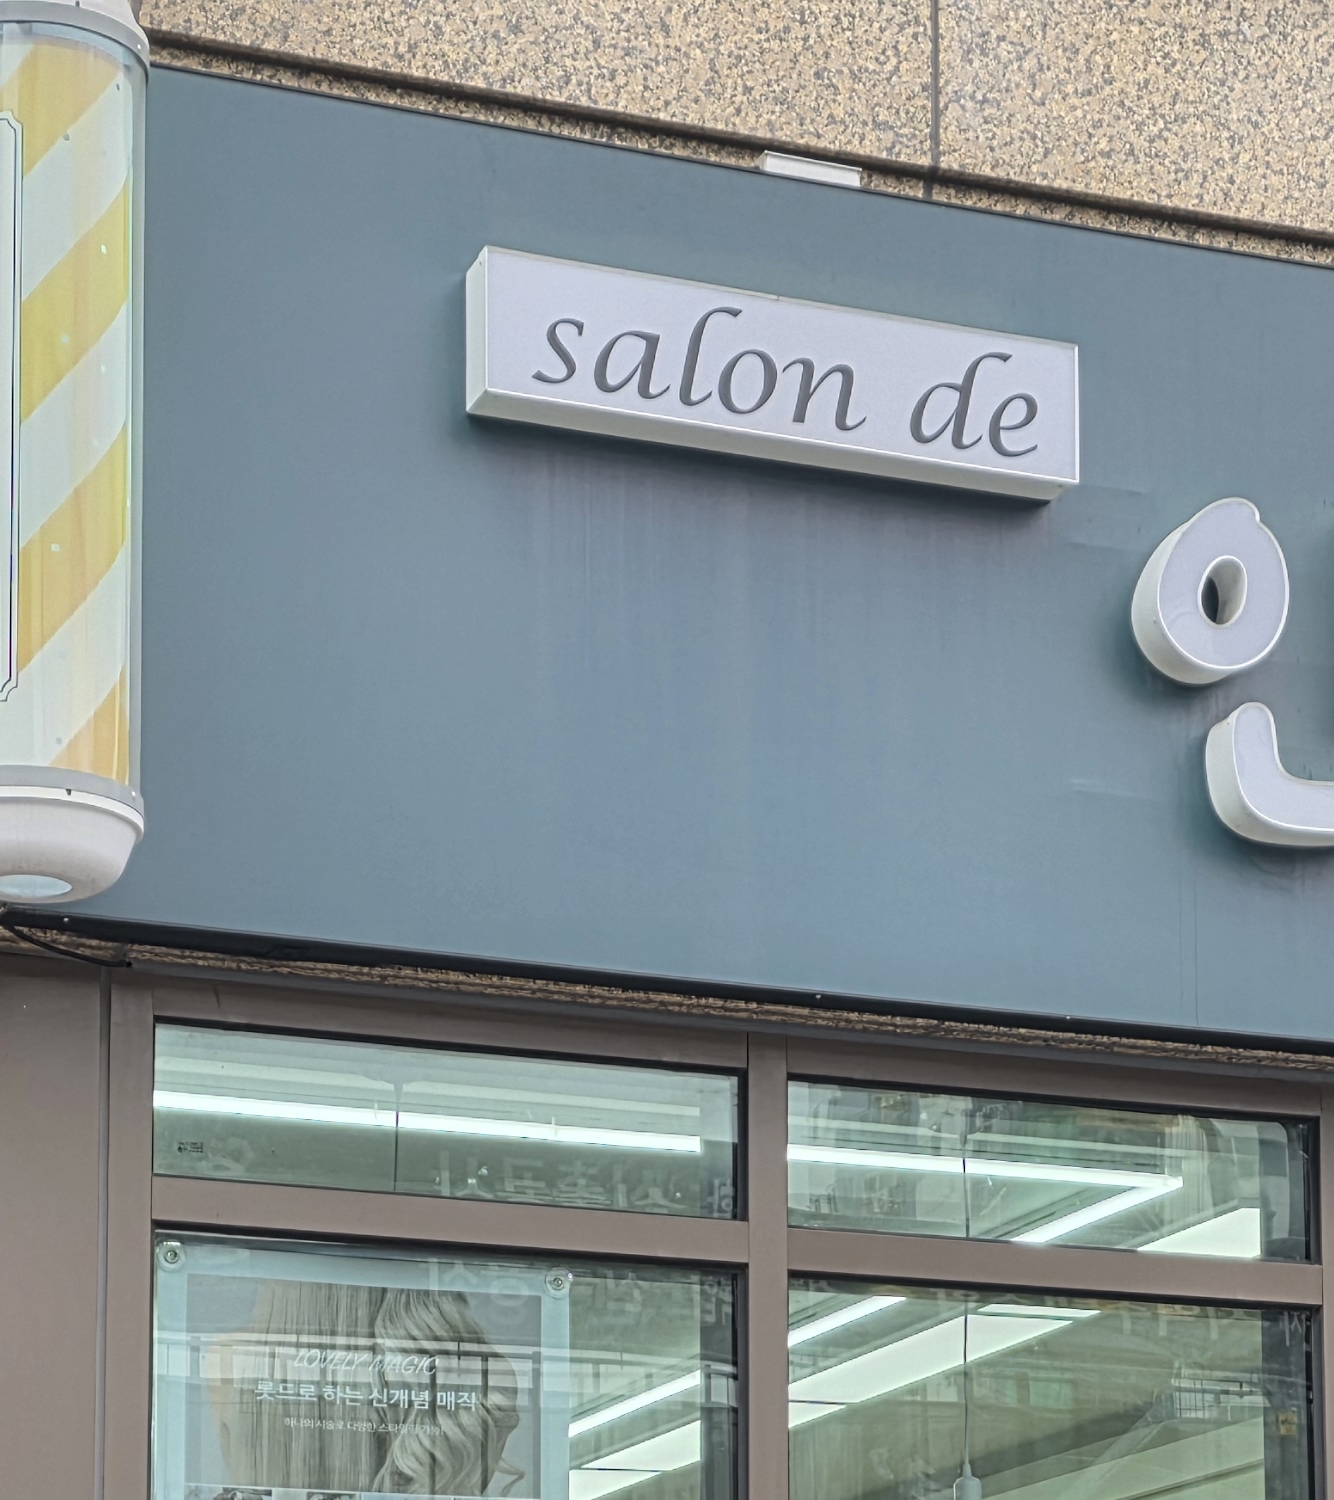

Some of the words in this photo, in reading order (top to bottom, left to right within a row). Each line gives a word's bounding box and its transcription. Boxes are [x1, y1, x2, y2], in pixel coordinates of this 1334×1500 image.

[531, 305, 867, 432] salon
[909, 351, 1039, 457] de
[293, 1348, 368, 1372] LOVELY
[368, 1355, 440, 1375] MAGIC
[254, 1380, 318, 1402] 롯드로
[322, 1385, 365, 1406] 하는
[369, 1389, 430, 1410] 신개념
[436, 1391, 477, 1412] 매직
